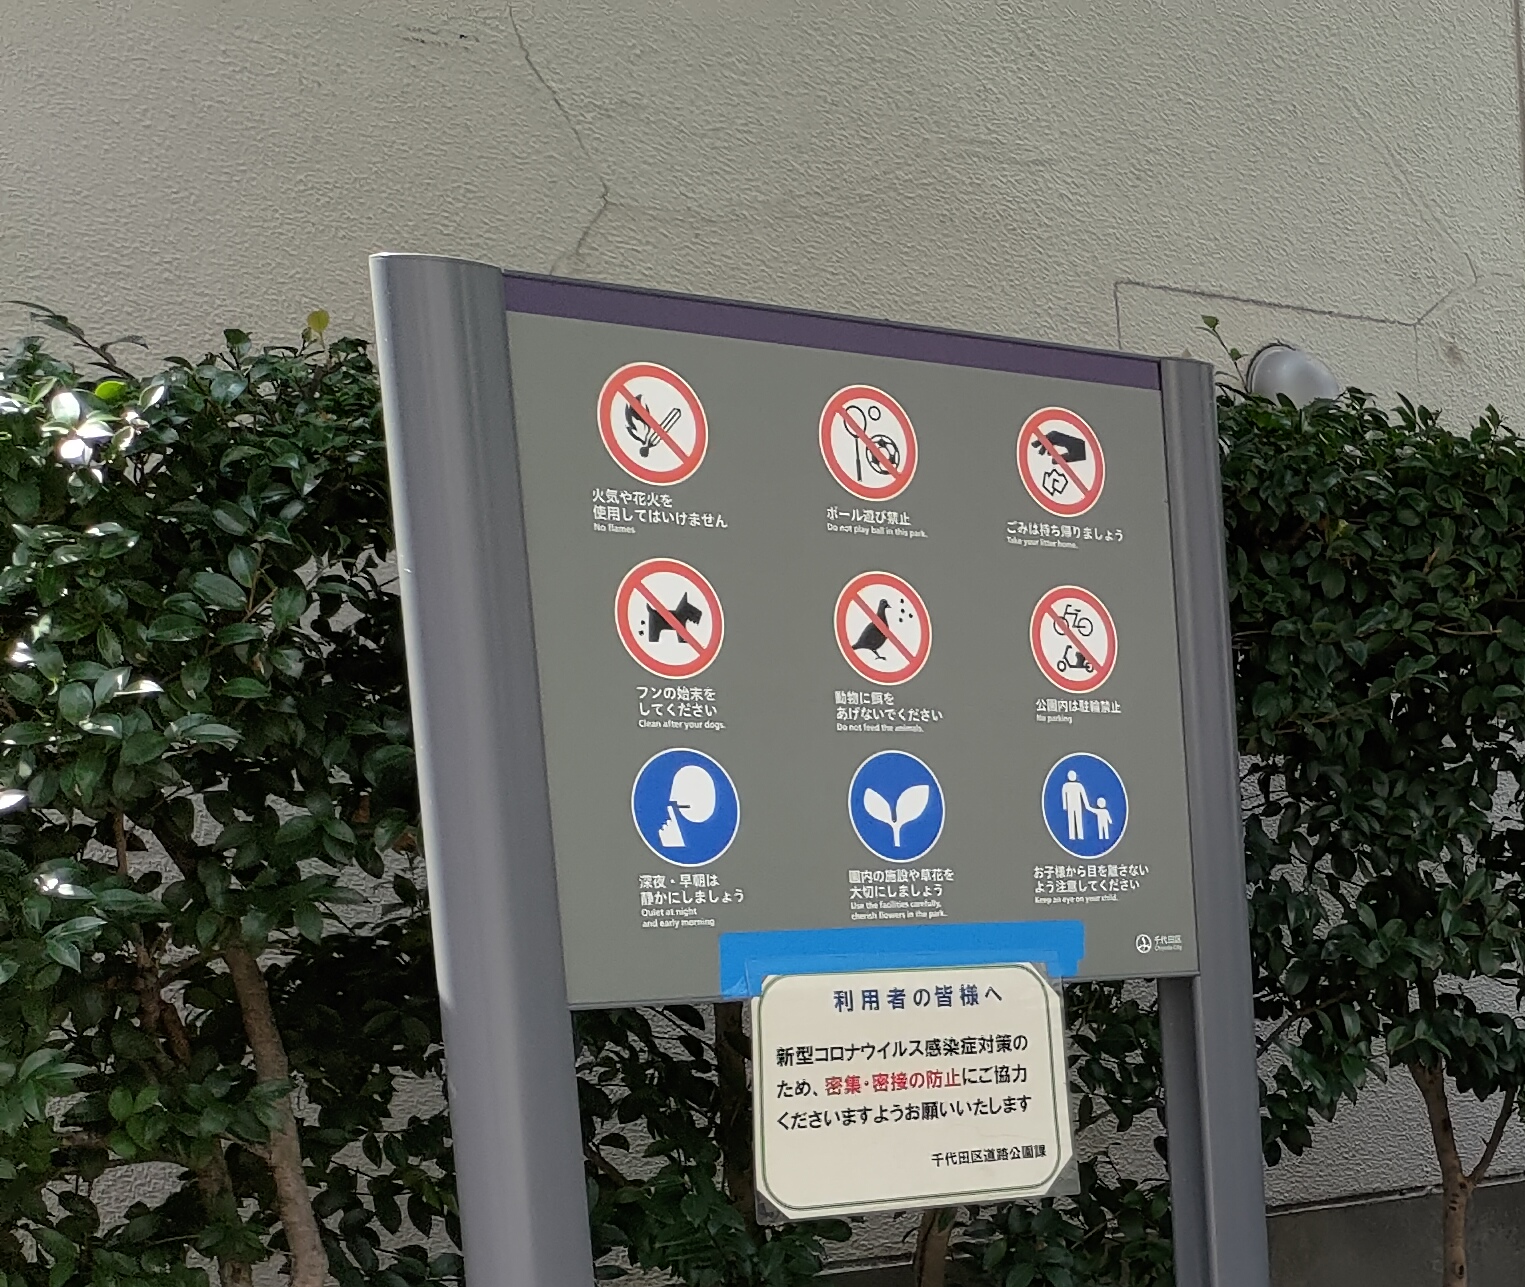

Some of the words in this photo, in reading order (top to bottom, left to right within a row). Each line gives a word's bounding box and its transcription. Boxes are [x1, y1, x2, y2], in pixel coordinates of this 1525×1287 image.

[592, 488, 673, 508] 火気や花火を
[593, 504, 728, 528] 使用してはいけません
[826, 505, 911, 526] ボール遊び禁止
[593, 522, 606, 532] No
[827, 522, 838, 532] Do
[839, 524, 852, 533] not
[853, 525, 869, 536] play
[894, 528, 908, 537] this
[1006, 521, 1123, 541] ごみは持ち帰りましょう
[636, 686, 716, 701] フンの始末を
[639, 702, 718, 717] してください
[836, 706, 943, 722] あげないでください
[638, 719, 661, 728] Clean
[662, 719, 682, 729] after
[683, 721, 702, 730] your
[836, 723, 847, 732] Do
[848, 723, 862, 732] not
[639, 873, 720, 889] 深夜・早朝は
[1034, 879, 1140, 893] よう注意してください
[640, 888, 744, 906] 静かにしましょう
[849, 883, 943, 900] 大切にしましょう
[641, 908, 664, 917] Quiet
[676, 907, 697, 917] night
[642, 919, 658, 928] and
[659, 919, 680, 929] early
[681, 918, 715, 927] morning
[833, 984, 1003, 1013] 利用者の皆様へ
[775, 1033, 1028, 1067] 新型コロナウイルス感染症対策の
[776, 1095, 1032, 1131] くださいますようお願いいたします
[931, 1144, 1047, 1167] 千代田区道路公園課
